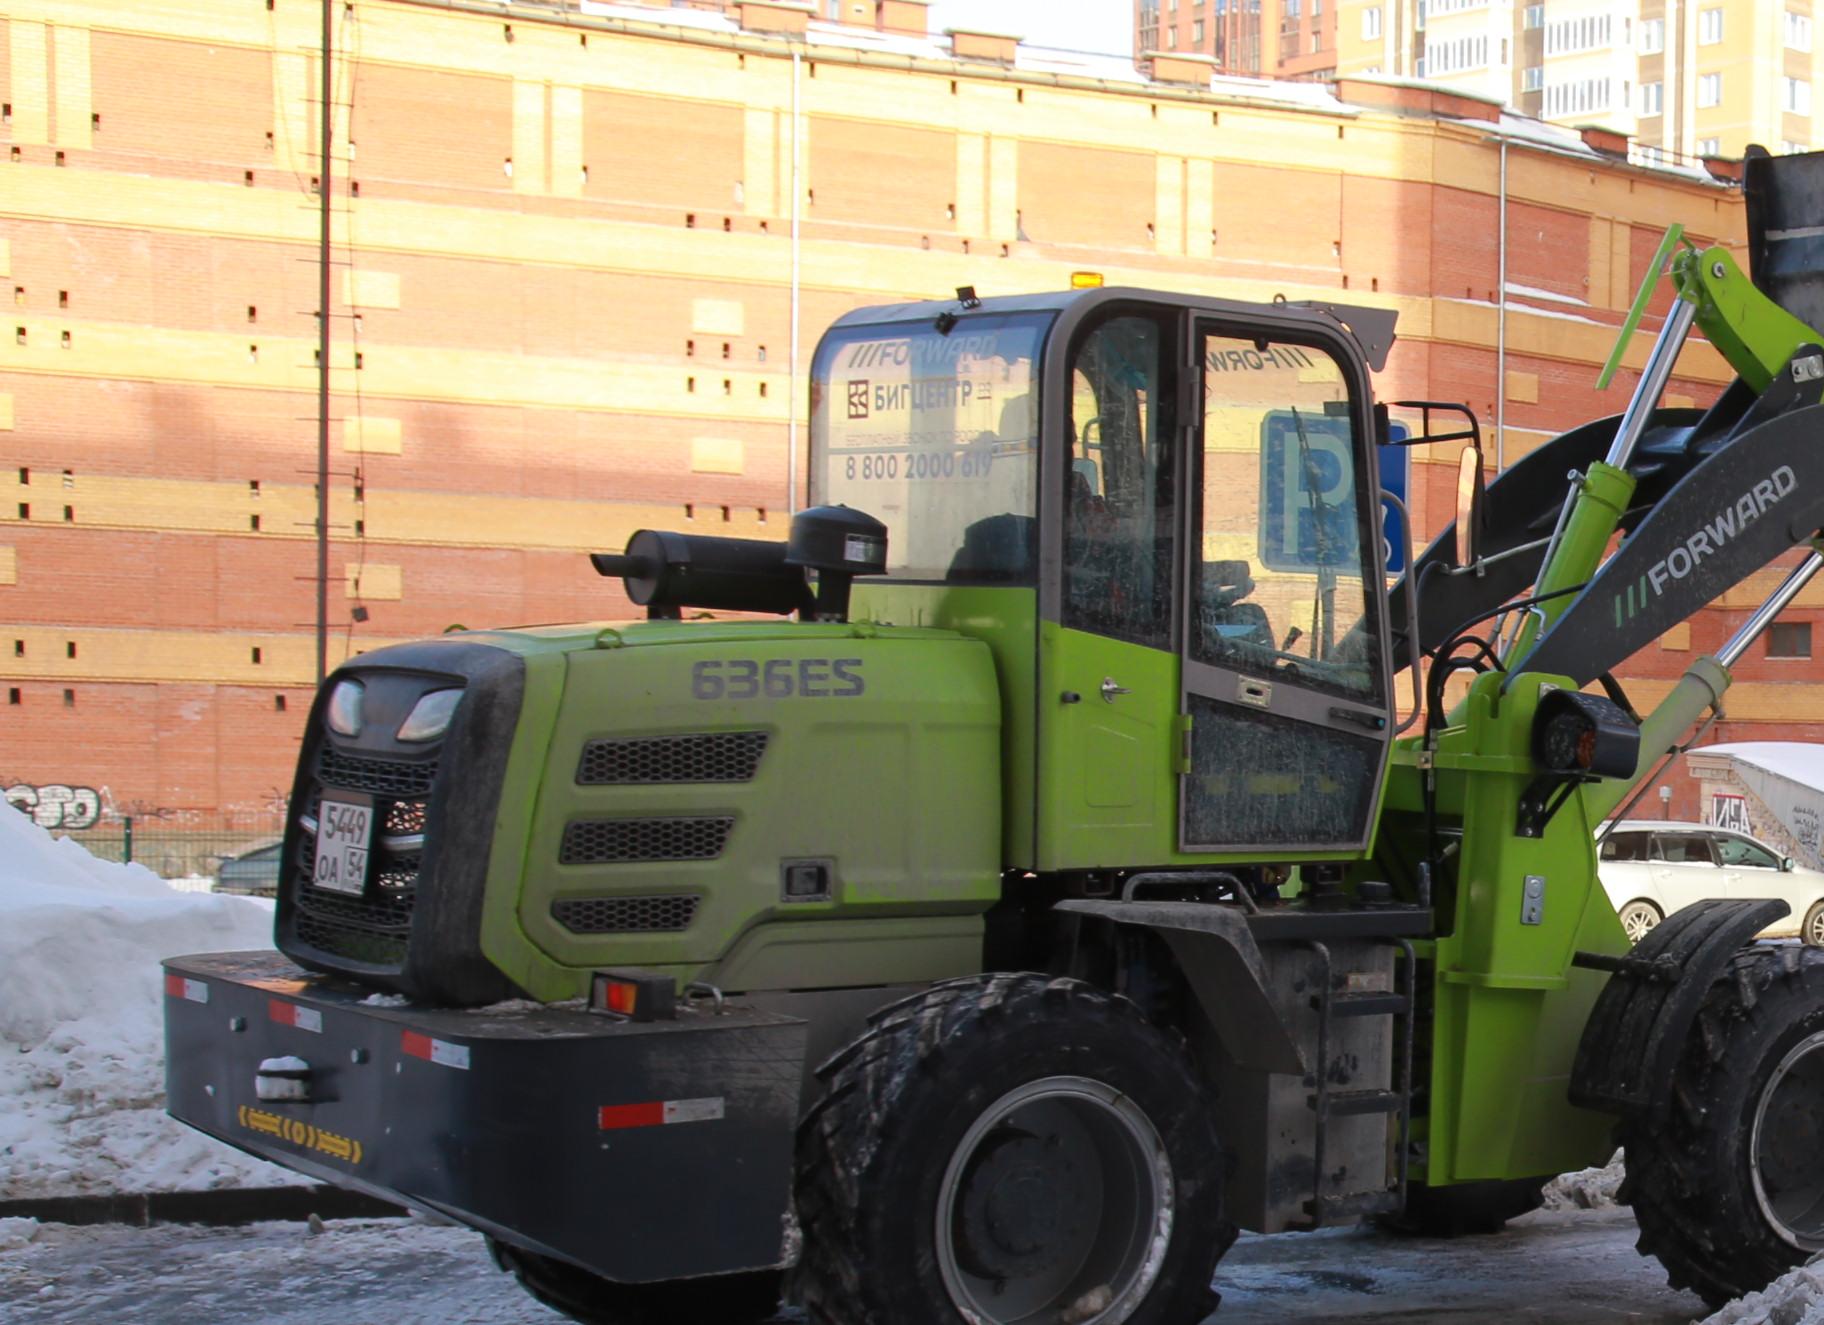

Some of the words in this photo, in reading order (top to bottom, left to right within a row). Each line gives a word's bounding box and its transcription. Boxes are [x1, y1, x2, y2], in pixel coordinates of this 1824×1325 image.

[875, 379, 973, 414] БИГЦЕНТР
[846, 455, 857, 481] 8
[862, 454, 898, 480] 800
[904, 452, 954, 479] 2000
[961, 449, 993, 478] 619
[1283, 431, 1354, 554] P
[1647, 464, 1797, 596] FORWARD
[692, 658, 865, 700] 636ES
[325, 804, 366, 844] 5449
[318, 854, 338, 882] ОА
[347, 851, 364, 879] 54
